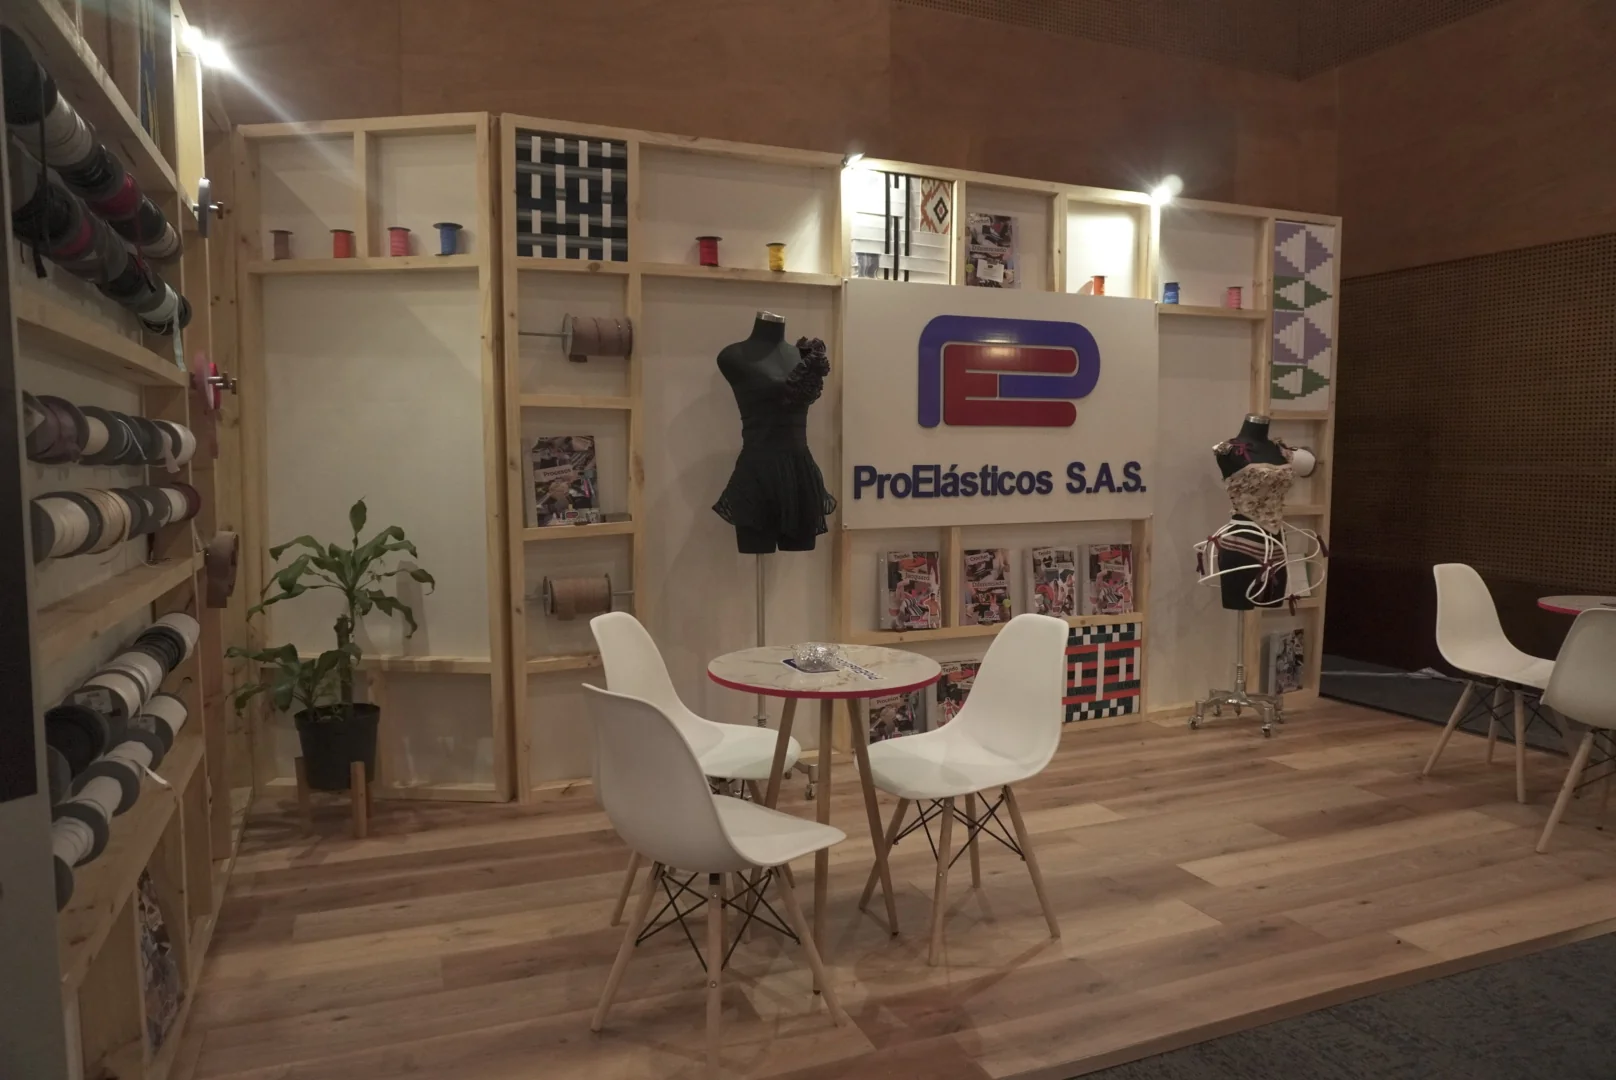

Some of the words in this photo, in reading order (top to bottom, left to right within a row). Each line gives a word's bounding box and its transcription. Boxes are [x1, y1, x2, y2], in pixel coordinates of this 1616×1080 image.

[543, 468, 571, 477] Procesos
[853, 464, 1053, 499] ProElásticos
[1065, 461, 1147, 494] S.A.S.
